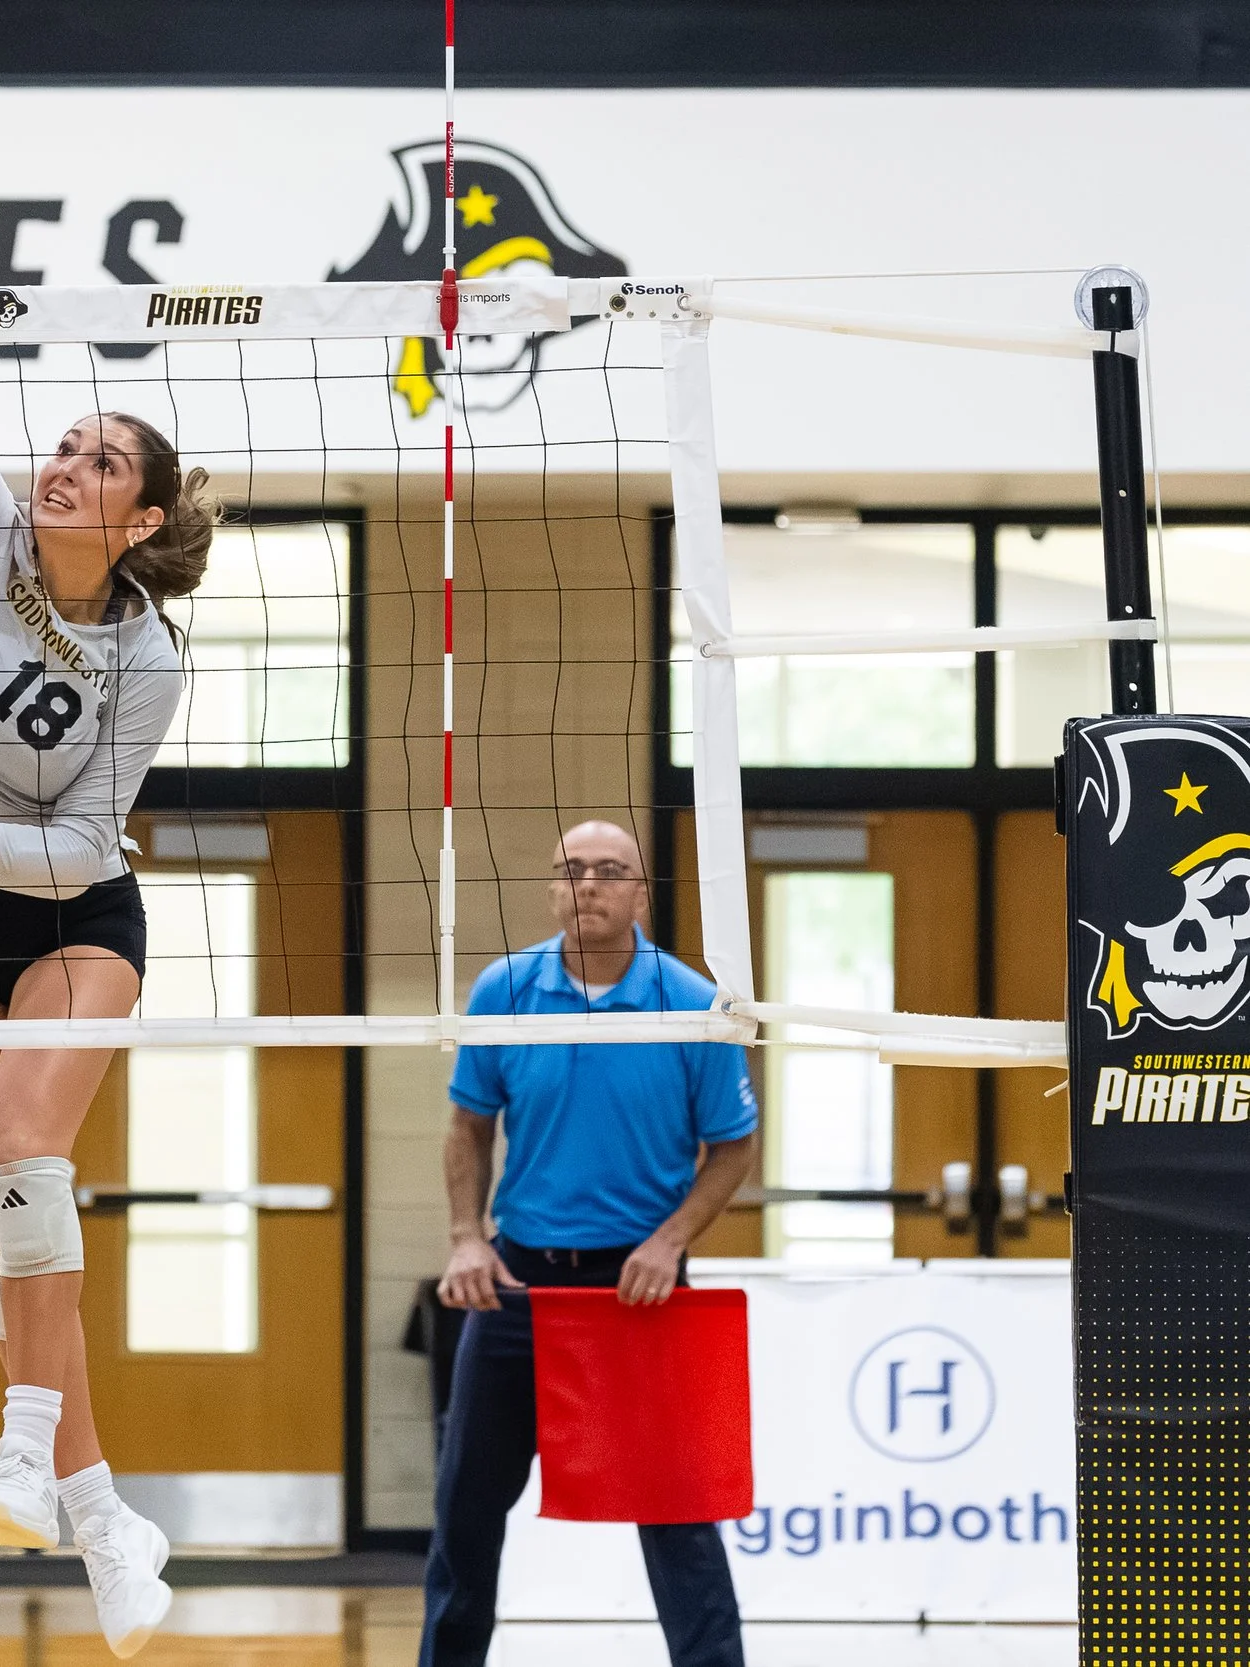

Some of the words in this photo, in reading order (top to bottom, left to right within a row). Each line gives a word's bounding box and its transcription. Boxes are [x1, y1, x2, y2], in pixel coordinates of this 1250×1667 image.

[635, 284, 685, 295] Senoh
[470, 293, 511, 305] imports
[146, 293, 264, 328] PIRATES
[1133, 1054, 1250, 1070] SOUTHWESTERN
[735, 1488, 1068, 1556] gginboth
